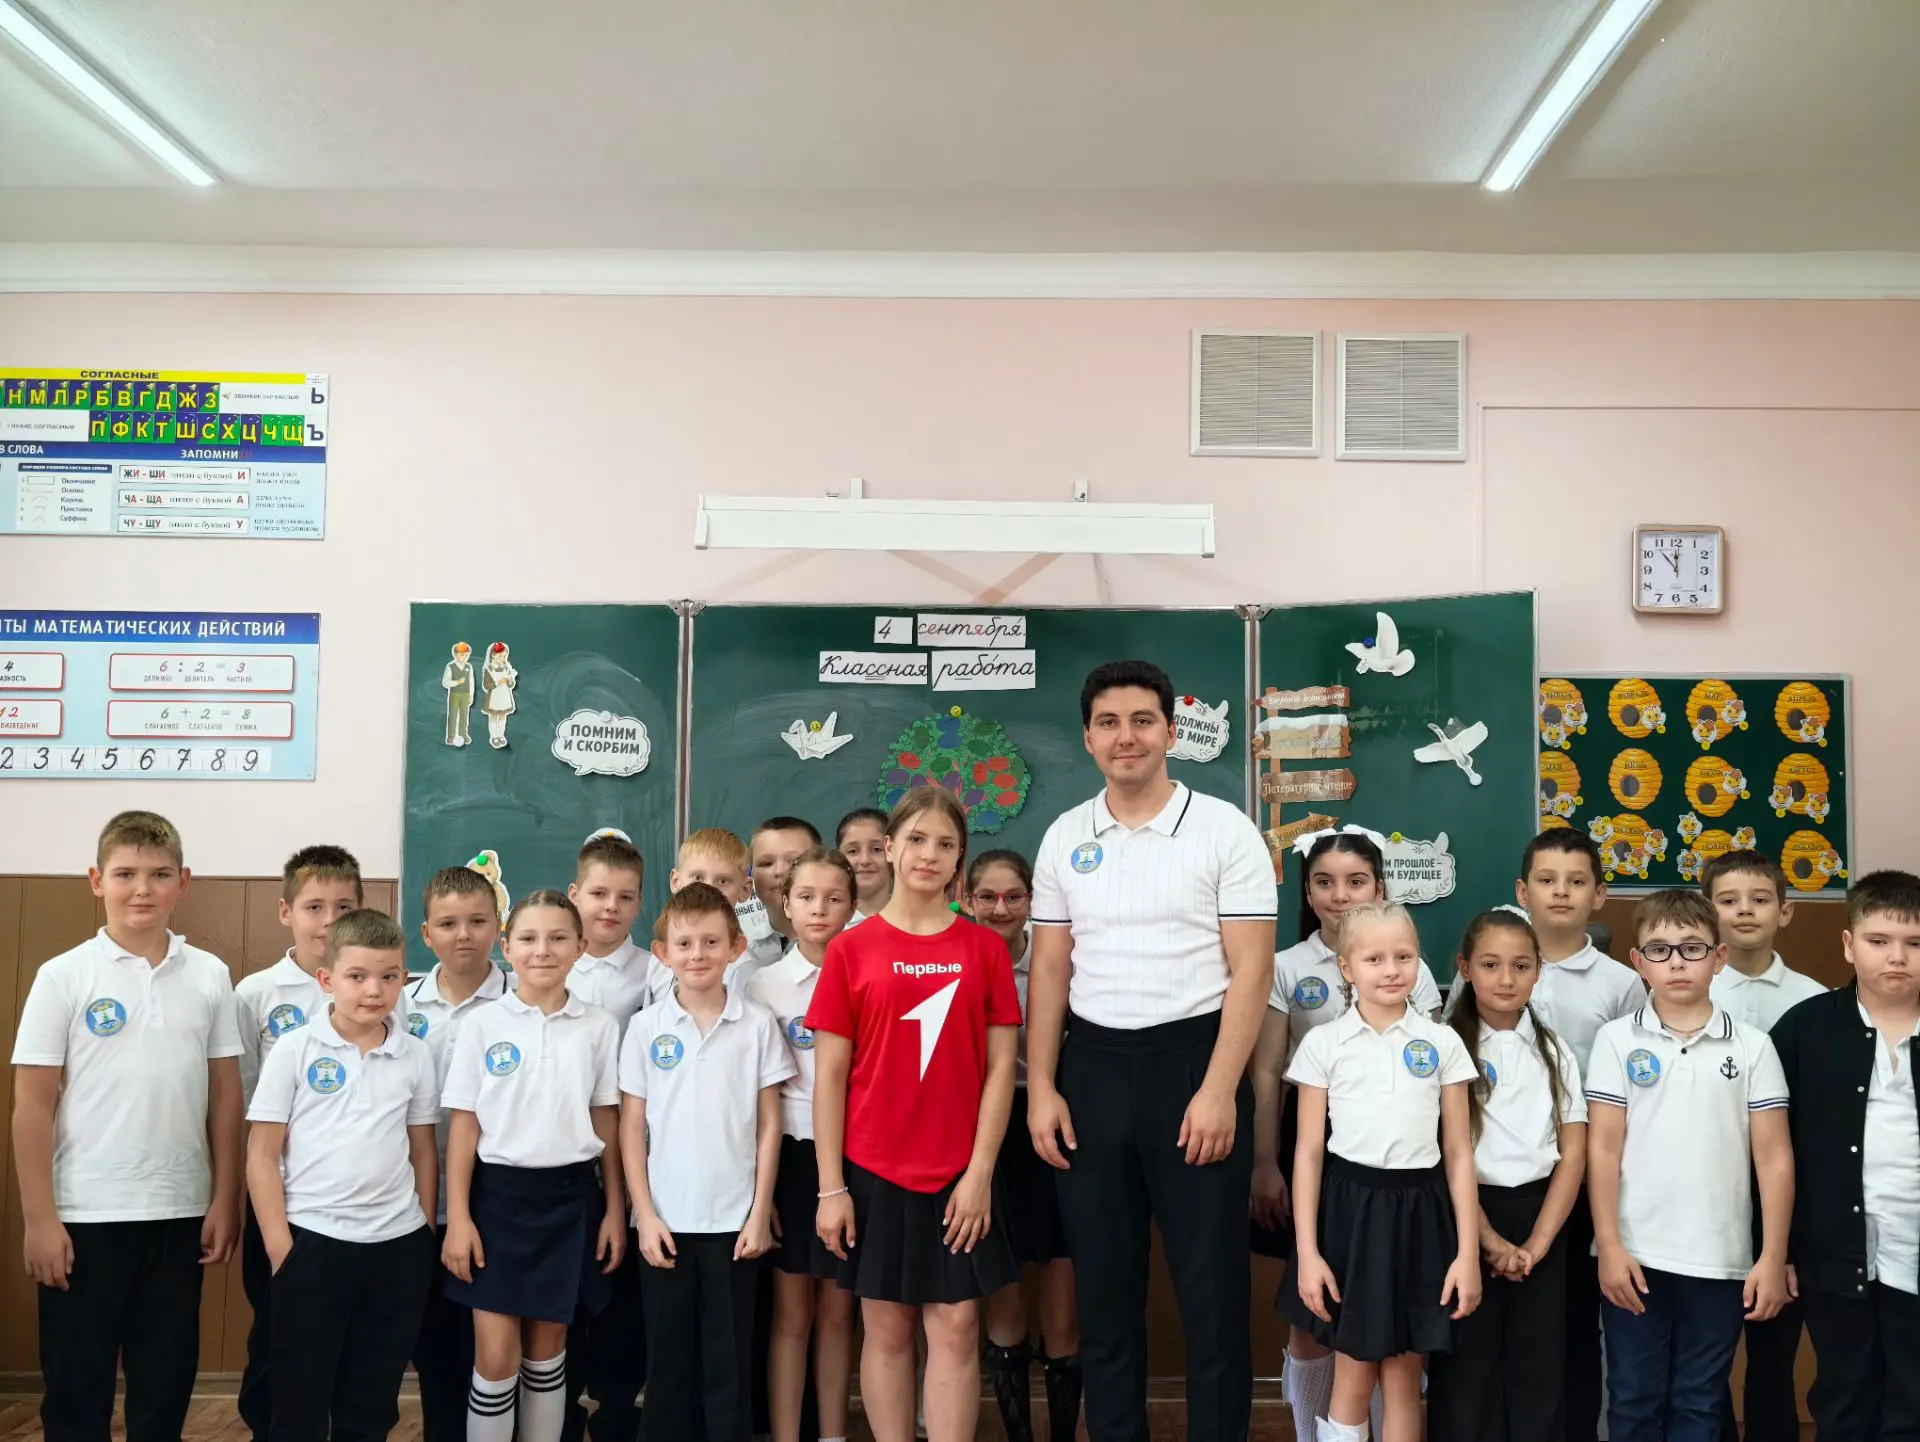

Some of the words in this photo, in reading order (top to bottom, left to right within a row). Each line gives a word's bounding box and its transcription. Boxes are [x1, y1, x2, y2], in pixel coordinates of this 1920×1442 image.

[80, 371, 159, 379] СОГЛАСНЫЕ
[9, 389, 22, 404] Н
[30, 389, 46, 405] М
[53, 389, 67, 405] Л
[75, 389, 88, 405] Р
[96, 390, 110, 406] Б
[118, 391, 131, 406] В
[140, 391, 151, 407] Г
[156, 391, 171, 411] Д
[179, 392, 197, 408] Ж
[204, 392, 216, 408] З
[311, 387, 325, 404] Ь
[92, 421, 105, 437] П
[112, 421, 129, 437] Ф
[137, 422, 148, 438] К
[156, 422, 168, 438] Т
[177, 423, 196, 439] Ш
[201, 423, 215, 439] С
[222, 423, 235, 440] Х
[243, 424, 256, 443] Ц
[264, 424, 276, 441] Ч
[283, 425, 303, 445] Щ
[307, 424, 324, 441] Ъ
[8, 444, 44, 454] СЛОВА
[124, 469, 139, 478] ЖИ
[149, 470, 166, 478] ШИ
[124, 495, 137, 503] ЧА
[146, 495, 162, 504] ЩА
[236, 496, 244, 504] А
[124, 519, 137, 527] ЧУ
[145, 520, 161, 529] ЩУ
[236, 520, 243, 528] У
[1655, 539, 1664, 547] 11
[1670, 539, 1683, 547] 12
[1643, 550, 1654, 559] 10
[1700, 550, 1709, 560] 2
[1643, 565, 1652, 575] 9
[1700, 566, 1709, 575] 3
[1643, 582, 1652, 591] 8
[1699, 584, 1707, 593] 4
[1654, 593, 1664, 602] 7
[1672, 593, 1680, 603] 6
[1690, 594, 1698, 603] 5
[33, 619, 191, 635] МАТЕМАТИЧЕСКИХ
[198, 619, 285, 637] ДЕЙСТВИЙ
[878, 619, 892, 639] 4
[160, 660, 168, 672] 6
[194, 662, 205, 673] 2
[237, 662, 245, 673] 3
[820, 655, 928, 678] Классная
[160, 707, 169, 719] 6
[200, 709, 211, 720] 2
[242, 709, 251, 720] 8
[570, 724, 636, 740] ПОМНИМ
[1177, 728, 1184, 739] В
[1187, 731, 1218, 748] МИРЕ
[563, 740, 572, 751] И
[576, 740, 640, 755] СКОРБИМ
[0, 746, 13, 769] 2
[33, 746, 49, 769] 3
[70, 747, 84, 769] 4
[102, 747, 118, 770] 5
[140, 748, 156, 770] 6
[177, 748, 191, 771] 7
[211, 748, 225, 771] 8
[243, 749, 258, 771] 9
[1394, 858, 1435, 868] ПРОШЛОЕ
[1397, 870, 1442, 881] БУДУЩЕЕ
[893, 962, 962, 978] Первые
